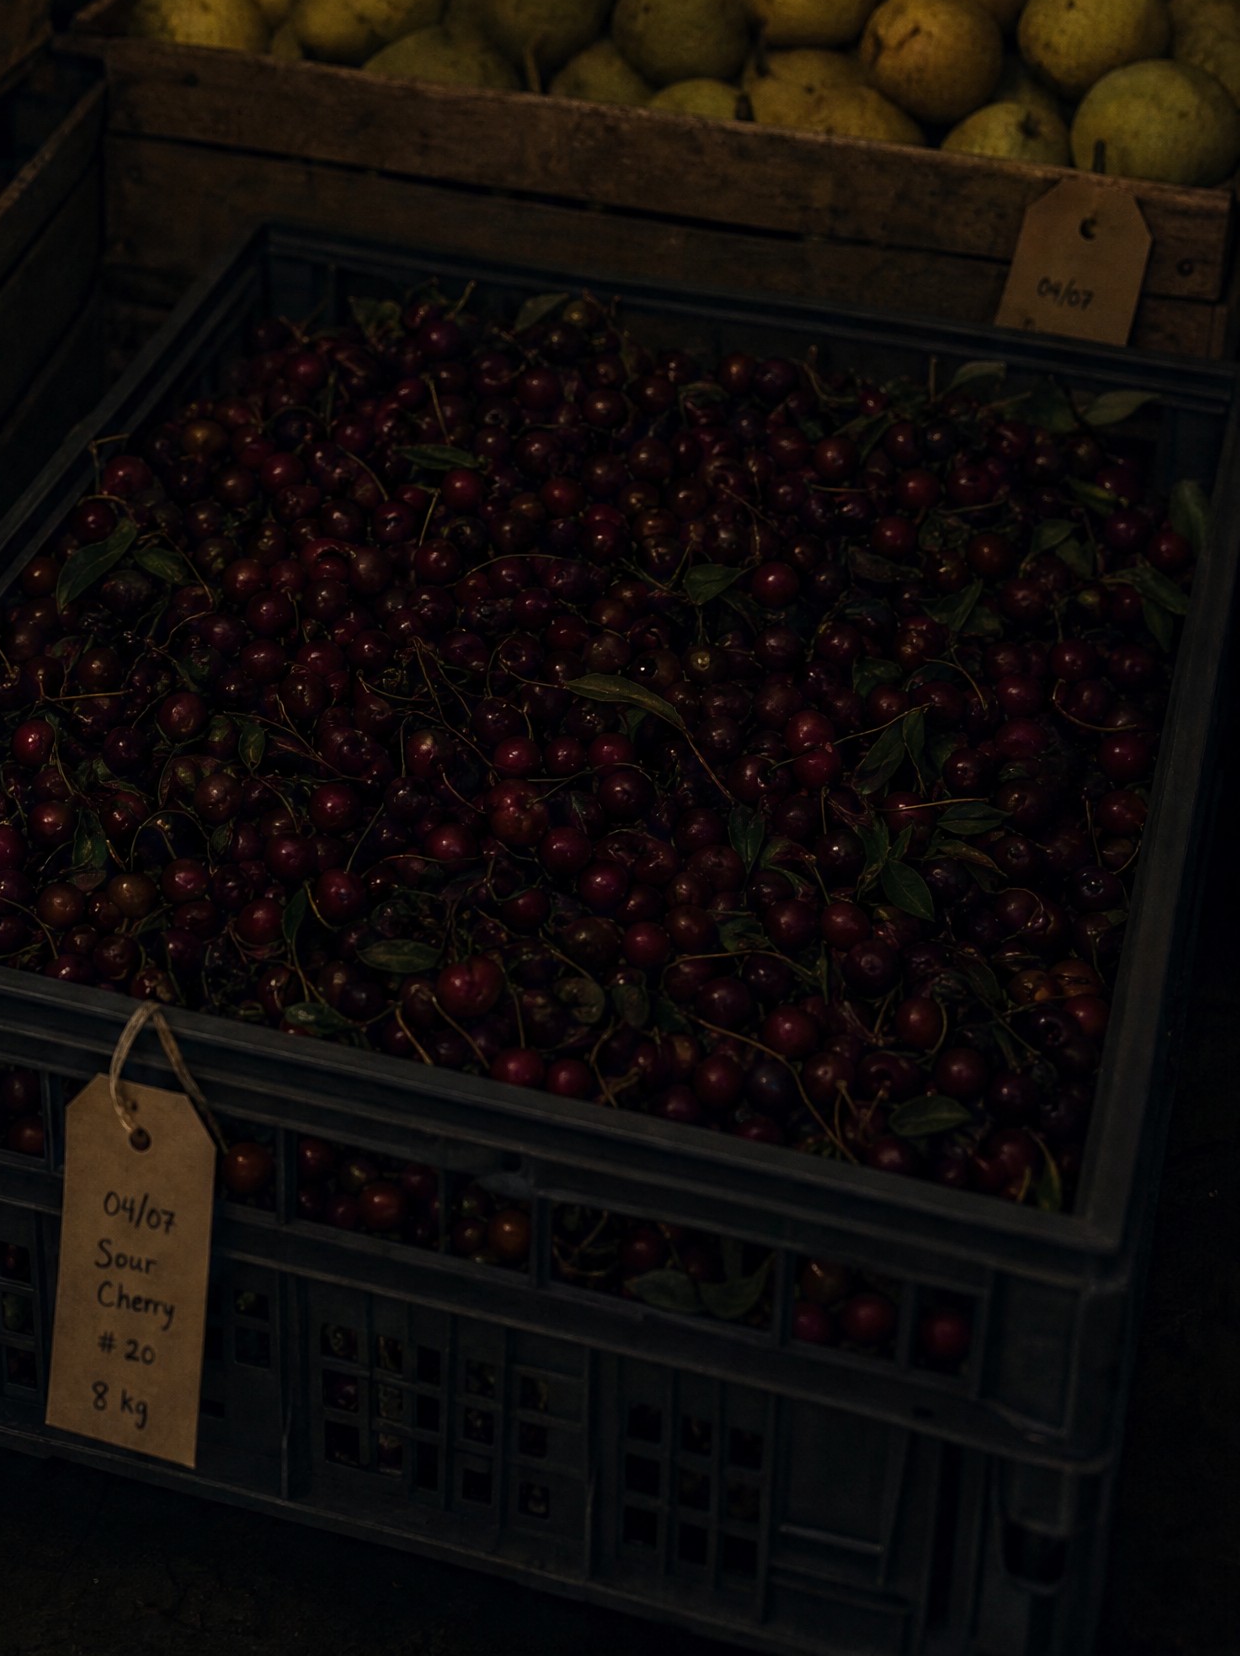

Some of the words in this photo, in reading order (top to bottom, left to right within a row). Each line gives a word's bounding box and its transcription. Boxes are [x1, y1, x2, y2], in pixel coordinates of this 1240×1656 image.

[1037, 277, 1094, 311] 04/07
[104, 1191, 175, 1234] 04/07
[94, 1239, 157, 1274] Sour
[97, 1281, 175, 1331] Cherry
[92, 1381, 109, 1411] 8
[121, 1390, 148, 1430] kg
